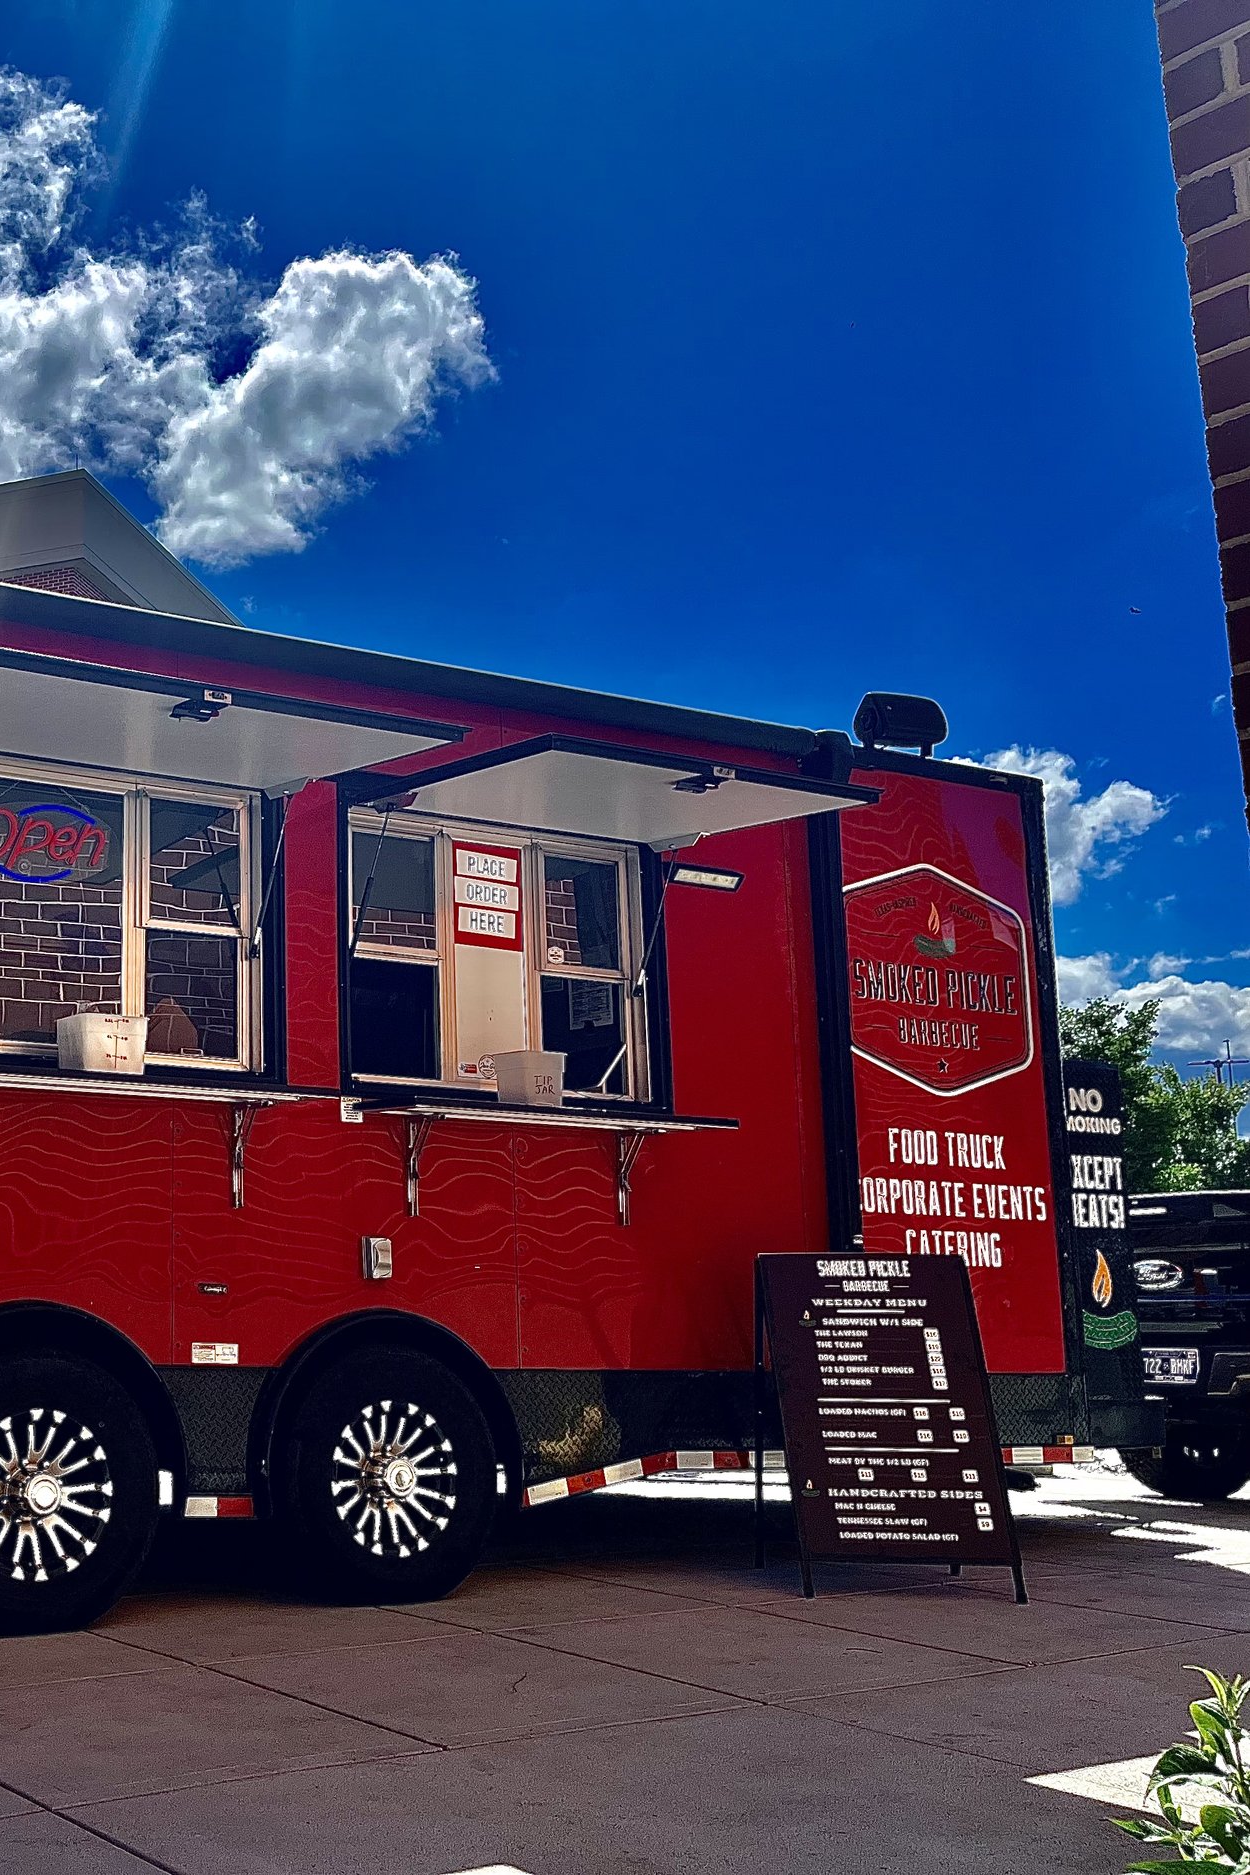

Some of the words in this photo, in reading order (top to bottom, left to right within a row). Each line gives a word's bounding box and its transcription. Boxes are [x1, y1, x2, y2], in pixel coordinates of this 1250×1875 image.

[467, 856, 506, 878] PLACE
[466, 882, 508, 905] ORDER
[469, 911, 504, 934] HERE
[853, 958, 939, 1007] SMOKED
[945, 968, 1018, 1015] PICKLE
[898, 1016, 980, 1051] BARBECUE
[534, 1075, 553, 1086] TIP
[535, 1084, 555, 1095] JAR
[1068, 1087, 1102, 1112] NO
[1066, 1115, 1121, 1135] MOKING
[888, 1127, 939, 1165] FOOD
[944, 1131, 1006, 1170] TRUCK
[1070, 1154, 1123, 1190] XCEPT
[859, 1177, 967, 1218] ORPORATE
[972, 1183, 1047, 1221] EVENTS
[1071, 1193, 1126, 1229] EATS!
[816, 1260, 867, 1277] SMOKED
[867, 1260, 911, 1277] PICKLE
[842, 1280, 890, 1292] BARBECUE
[811, 1299, 882, 1307] WEEKDAY
[885, 1299, 927, 1307] MENU
[822, 1318, 877, 1326] SANDWICH
[901, 1318, 924, 1327] SIDE
[1143, 1358, 1162, 1374] 722
[822, 1378, 839, 1386] THE
[818, 1407, 852, 1415] LOADED
[854, 1407, 889, 1416] NACHOS
[822, 1430, 856, 1438] LOADED
[857, 1431, 877, 1439] MAC
[827, 1488, 937, 1498] HANDCRAFTED
[940, 1490, 983, 1499] SIDES
[834, 1502, 854, 1510] MAC
[836, 1517, 884, 1525] TENNESSEE
[885, 1518, 909, 1526] SLAW
[839, 1531, 874, 1539] LOADED
[875, 1532, 911, 1540] POTATO
[912, 1533, 941, 1541] SALAD
